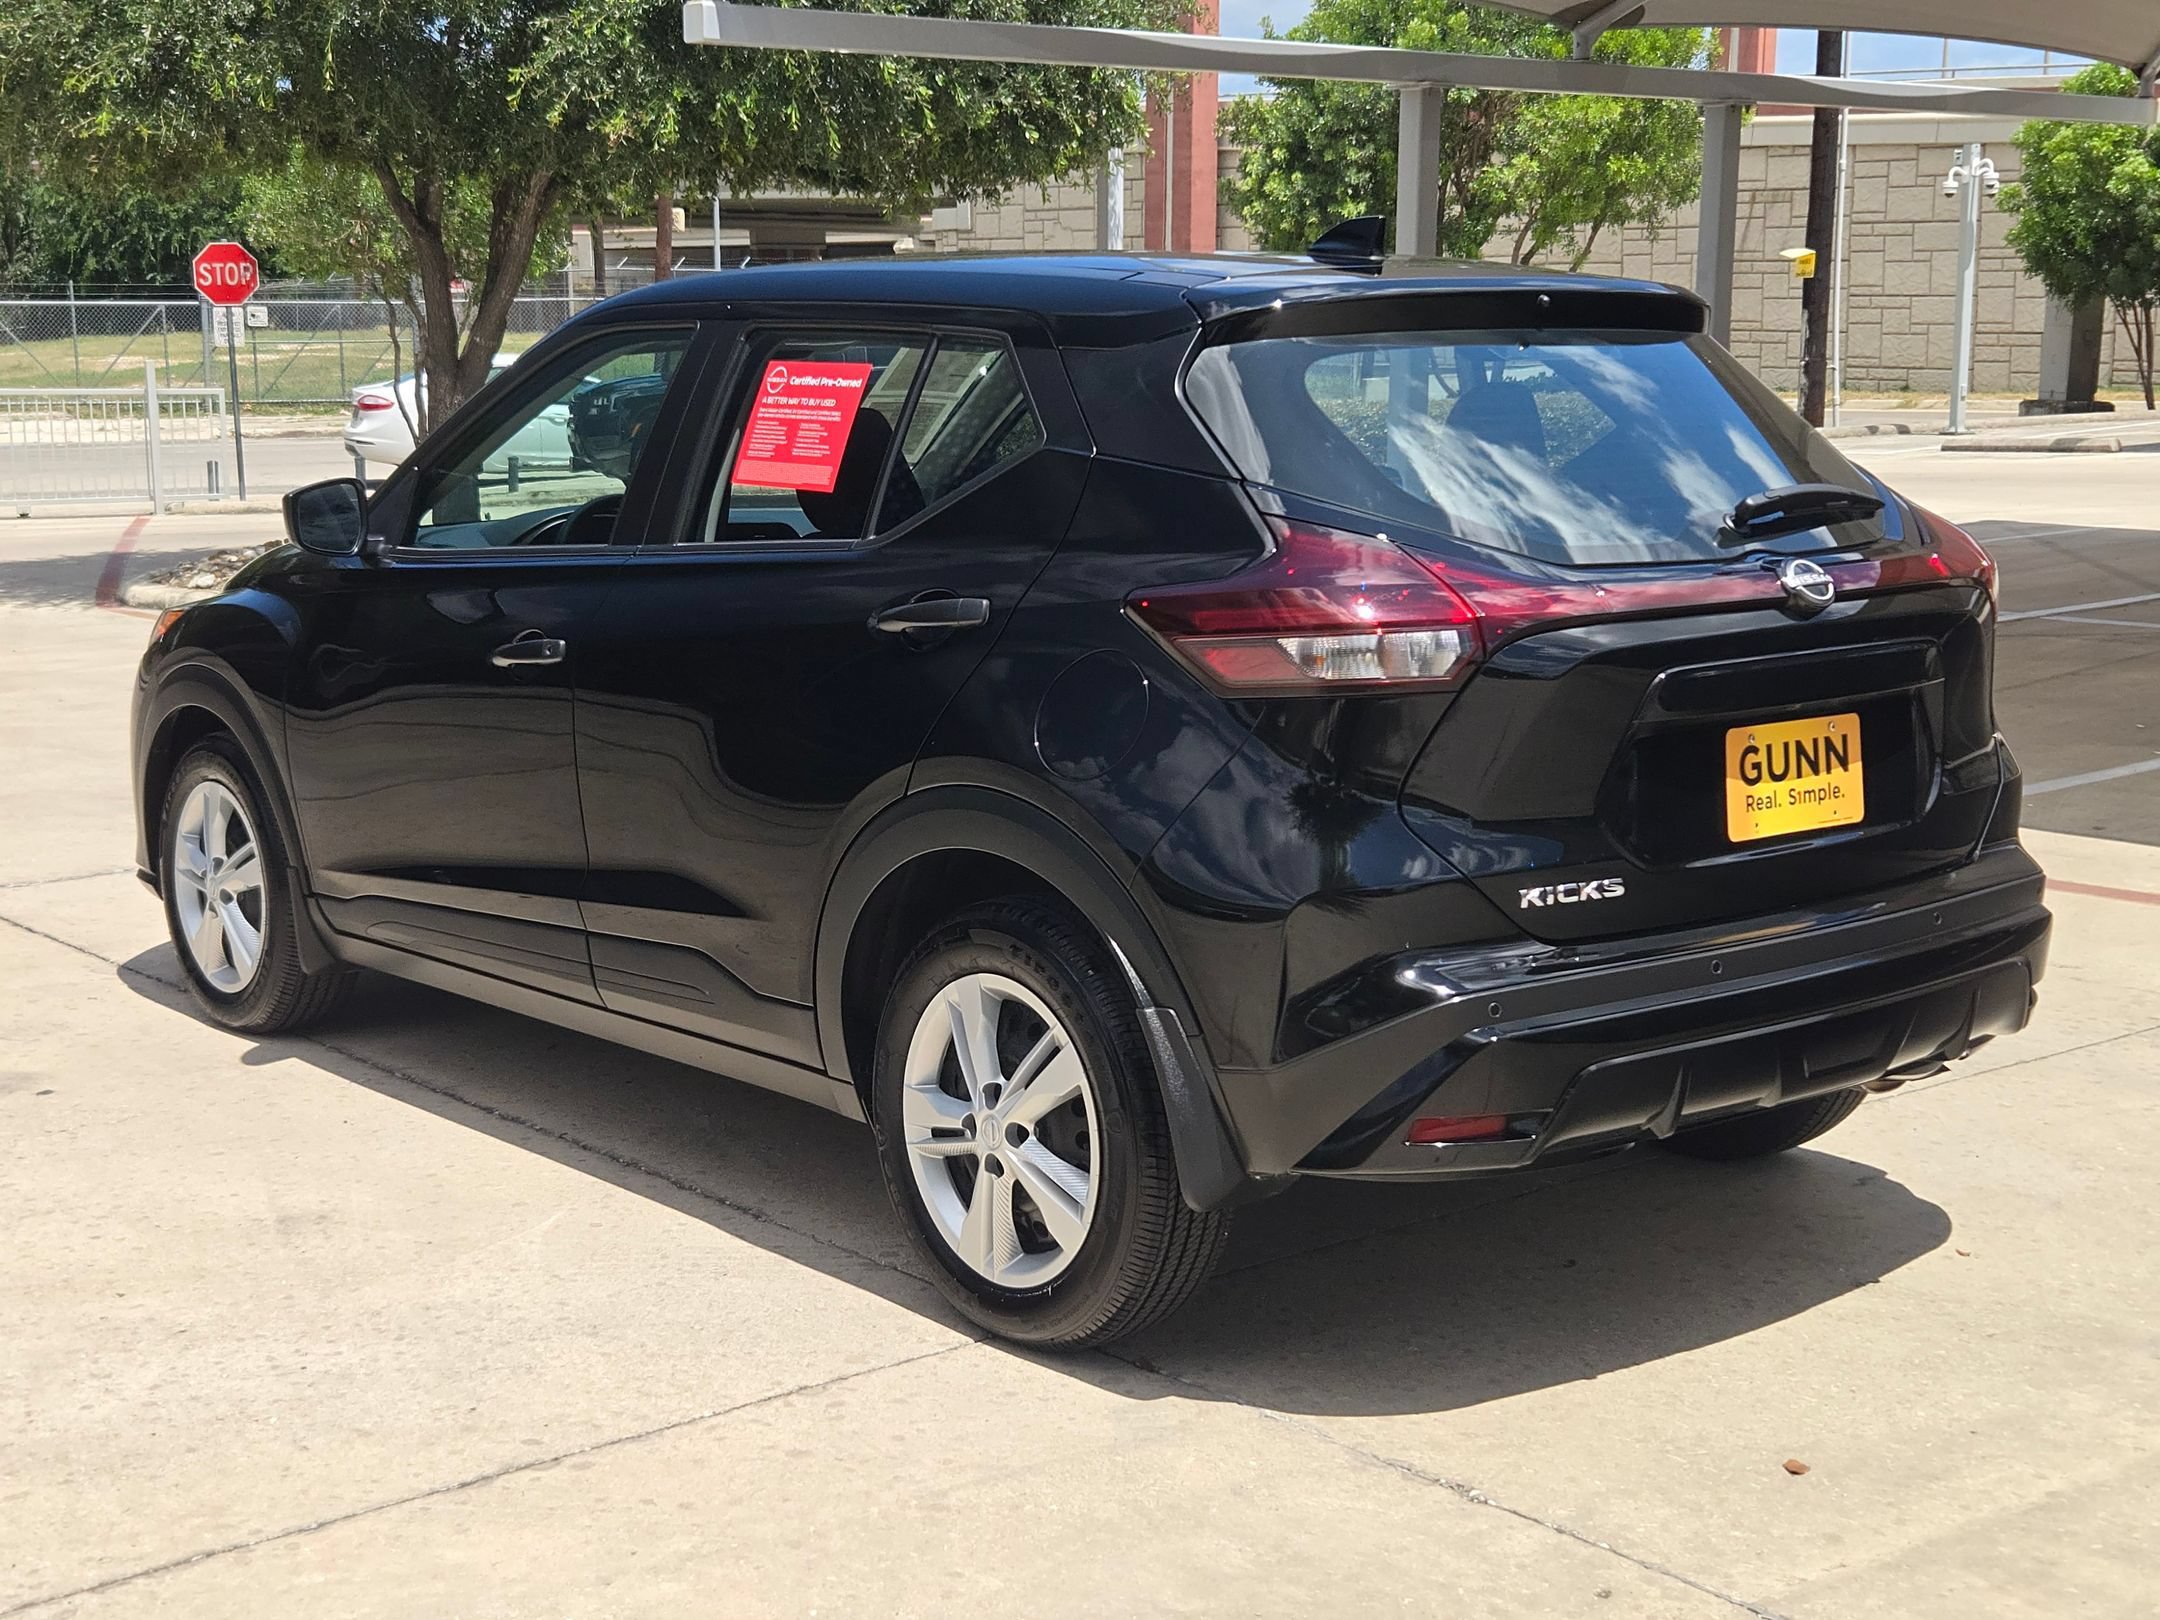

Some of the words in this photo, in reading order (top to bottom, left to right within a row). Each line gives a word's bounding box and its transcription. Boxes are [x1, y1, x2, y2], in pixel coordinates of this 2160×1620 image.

[199, 262, 253, 286] STOP
[789, 375, 820, 387] Certified
[820, 377, 862, 388] Pre-Owned
[767, 396, 788, 405] BETTER
[788, 397, 800, 405] WAY
[800, 398, 808, 406] TO
[808, 398, 820, 406] BUY
[820, 399, 836, 407] USED
[1739, 733, 1849, 787] GUNN
[1745, 790, 1782, 813] Real.
[1788, 782, 1845, 805] Simple.
[1518, 877, 1625, 909] KICKS
